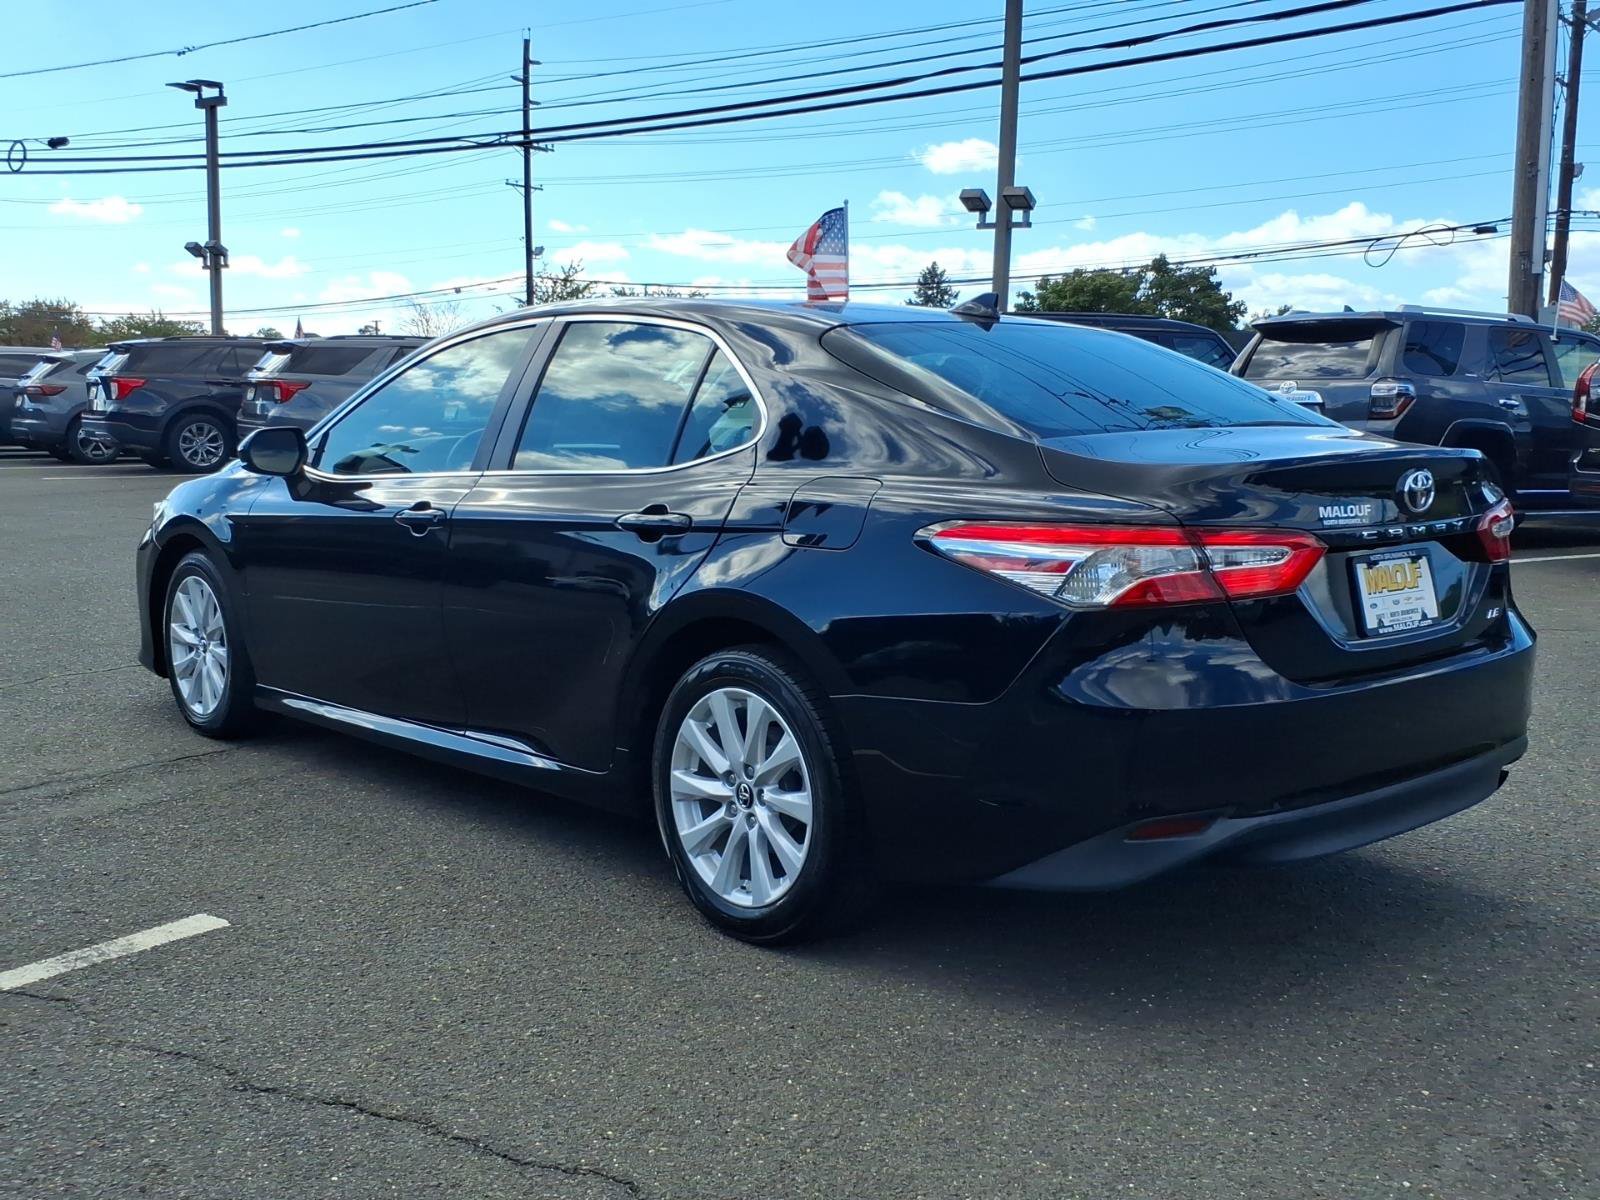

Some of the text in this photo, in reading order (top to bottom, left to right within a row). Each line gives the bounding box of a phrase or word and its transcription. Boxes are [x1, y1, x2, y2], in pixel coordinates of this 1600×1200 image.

[1319, 504, 1372, 518] MALOUF
[1362, 520, 1464, 540] CAMRY
[1364, 563, 1422, 595] MALOUF
[1486, 606, 1500, 619] LE
